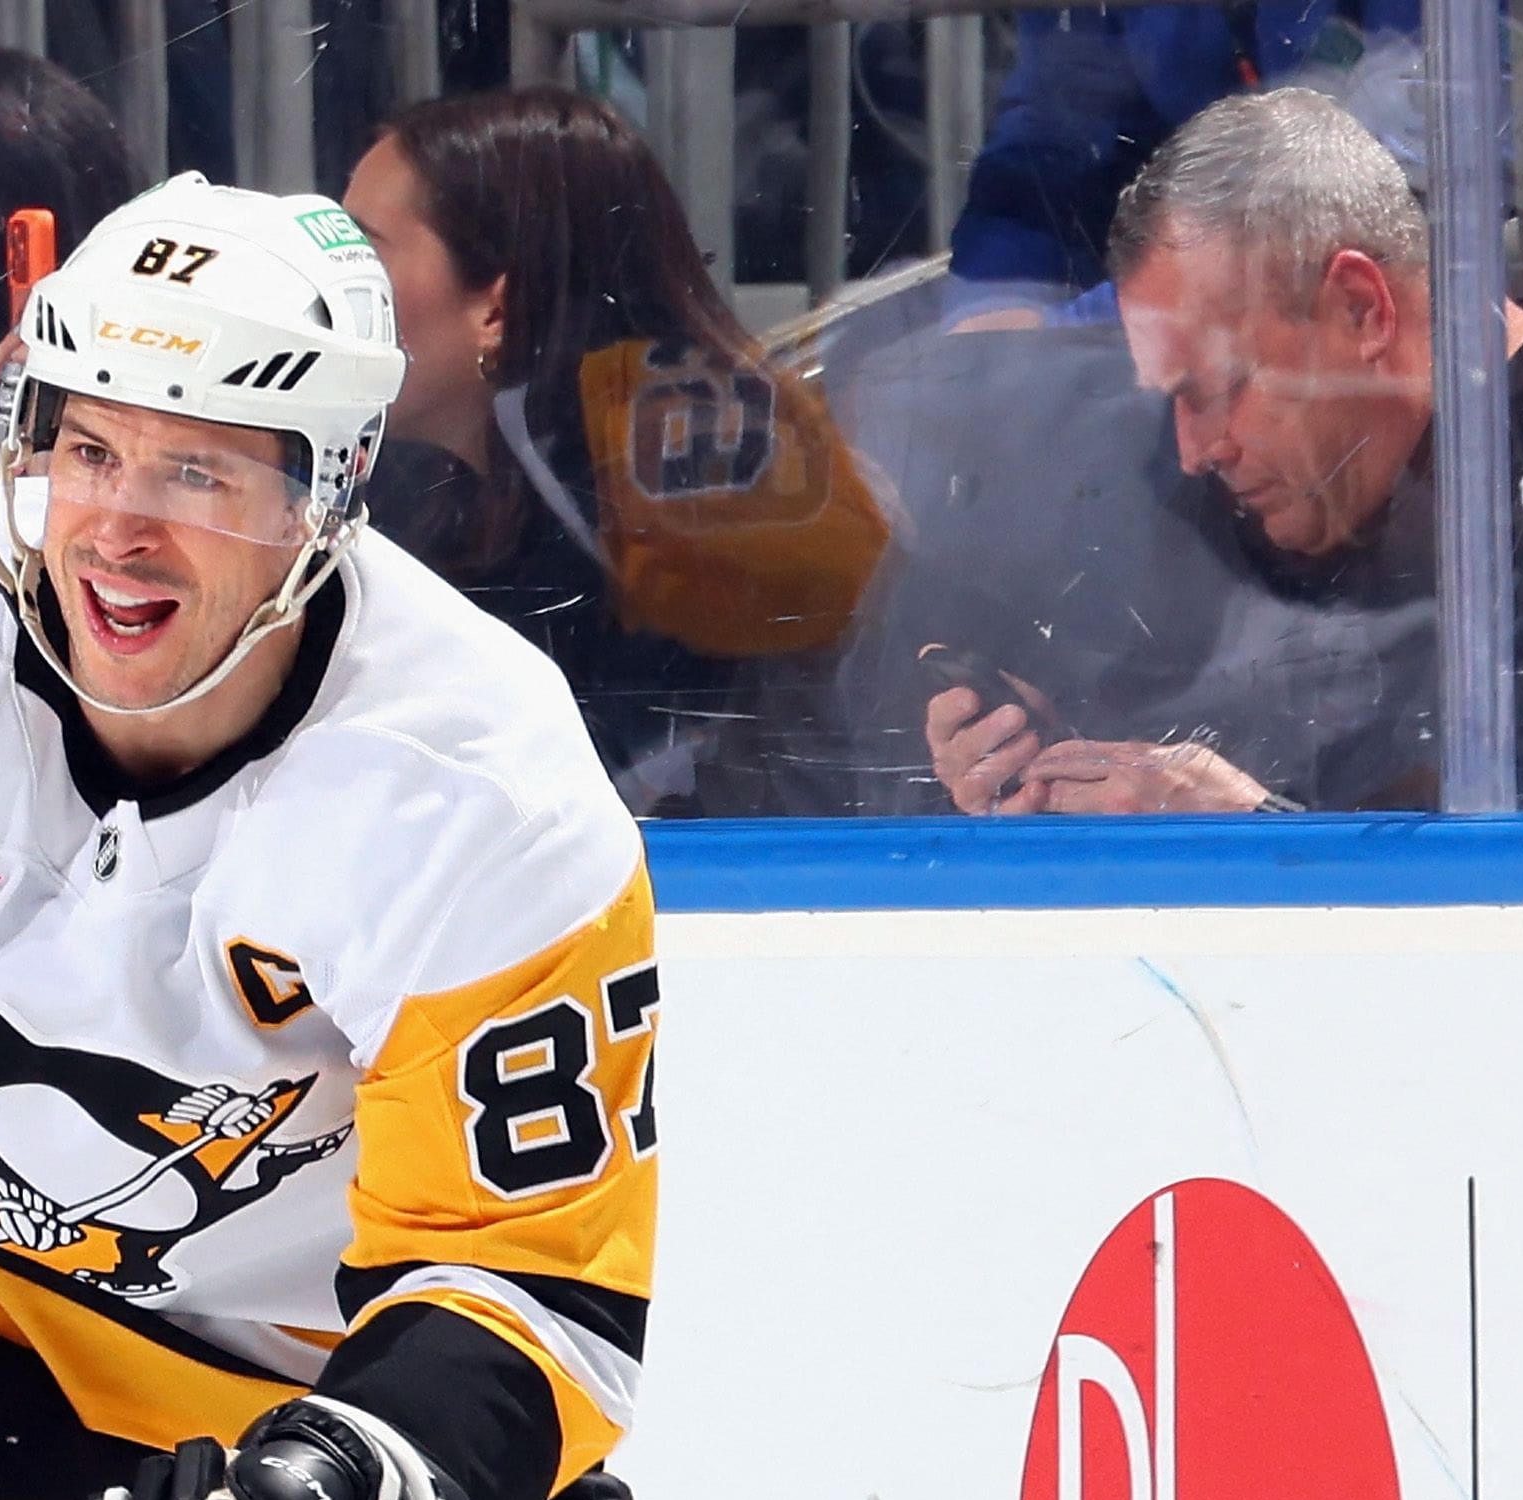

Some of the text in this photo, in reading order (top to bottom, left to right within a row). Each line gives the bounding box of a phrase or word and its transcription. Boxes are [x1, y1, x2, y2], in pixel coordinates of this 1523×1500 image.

[130, 237, 221, 285] 87
[98, 321, 203, 355] CCM
[223, 935, 314, 1030] C
